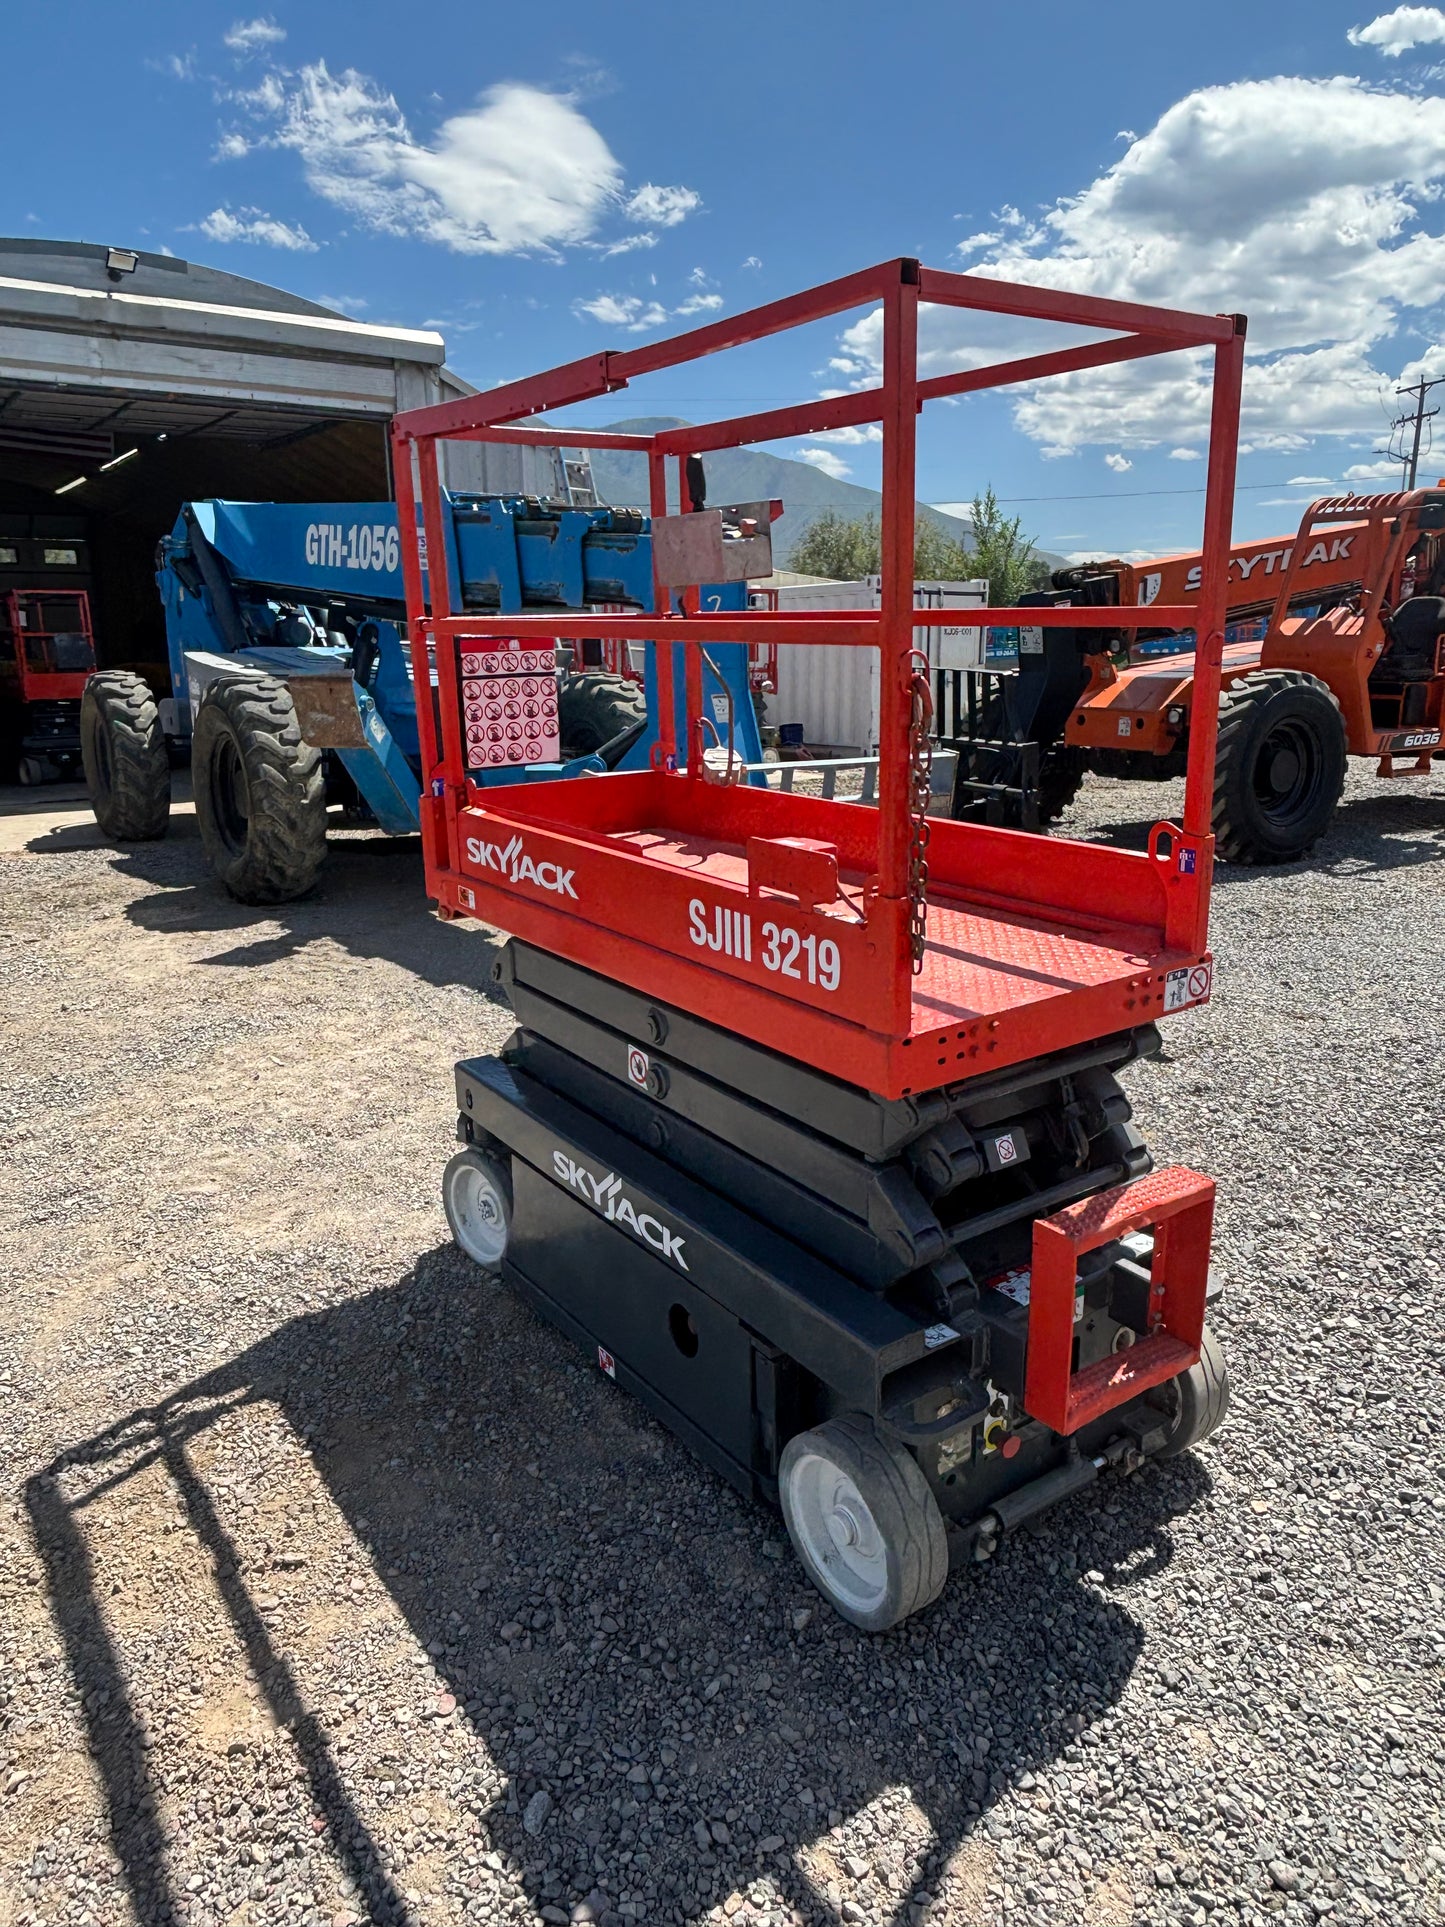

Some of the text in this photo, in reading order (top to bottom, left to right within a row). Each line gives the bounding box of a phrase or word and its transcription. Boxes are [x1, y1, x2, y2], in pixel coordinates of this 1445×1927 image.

[305, 524, 400, 573] GTH-1056
[1184, 536, 1356, 592] SYTAK
[1404, 733, 1441, 747] 6036
[466, 834, 580, 900] SKYJACK
[688, 898, 841, 991] SJIII 3219
[553, 1150, 690, 1272] SKYJACK
